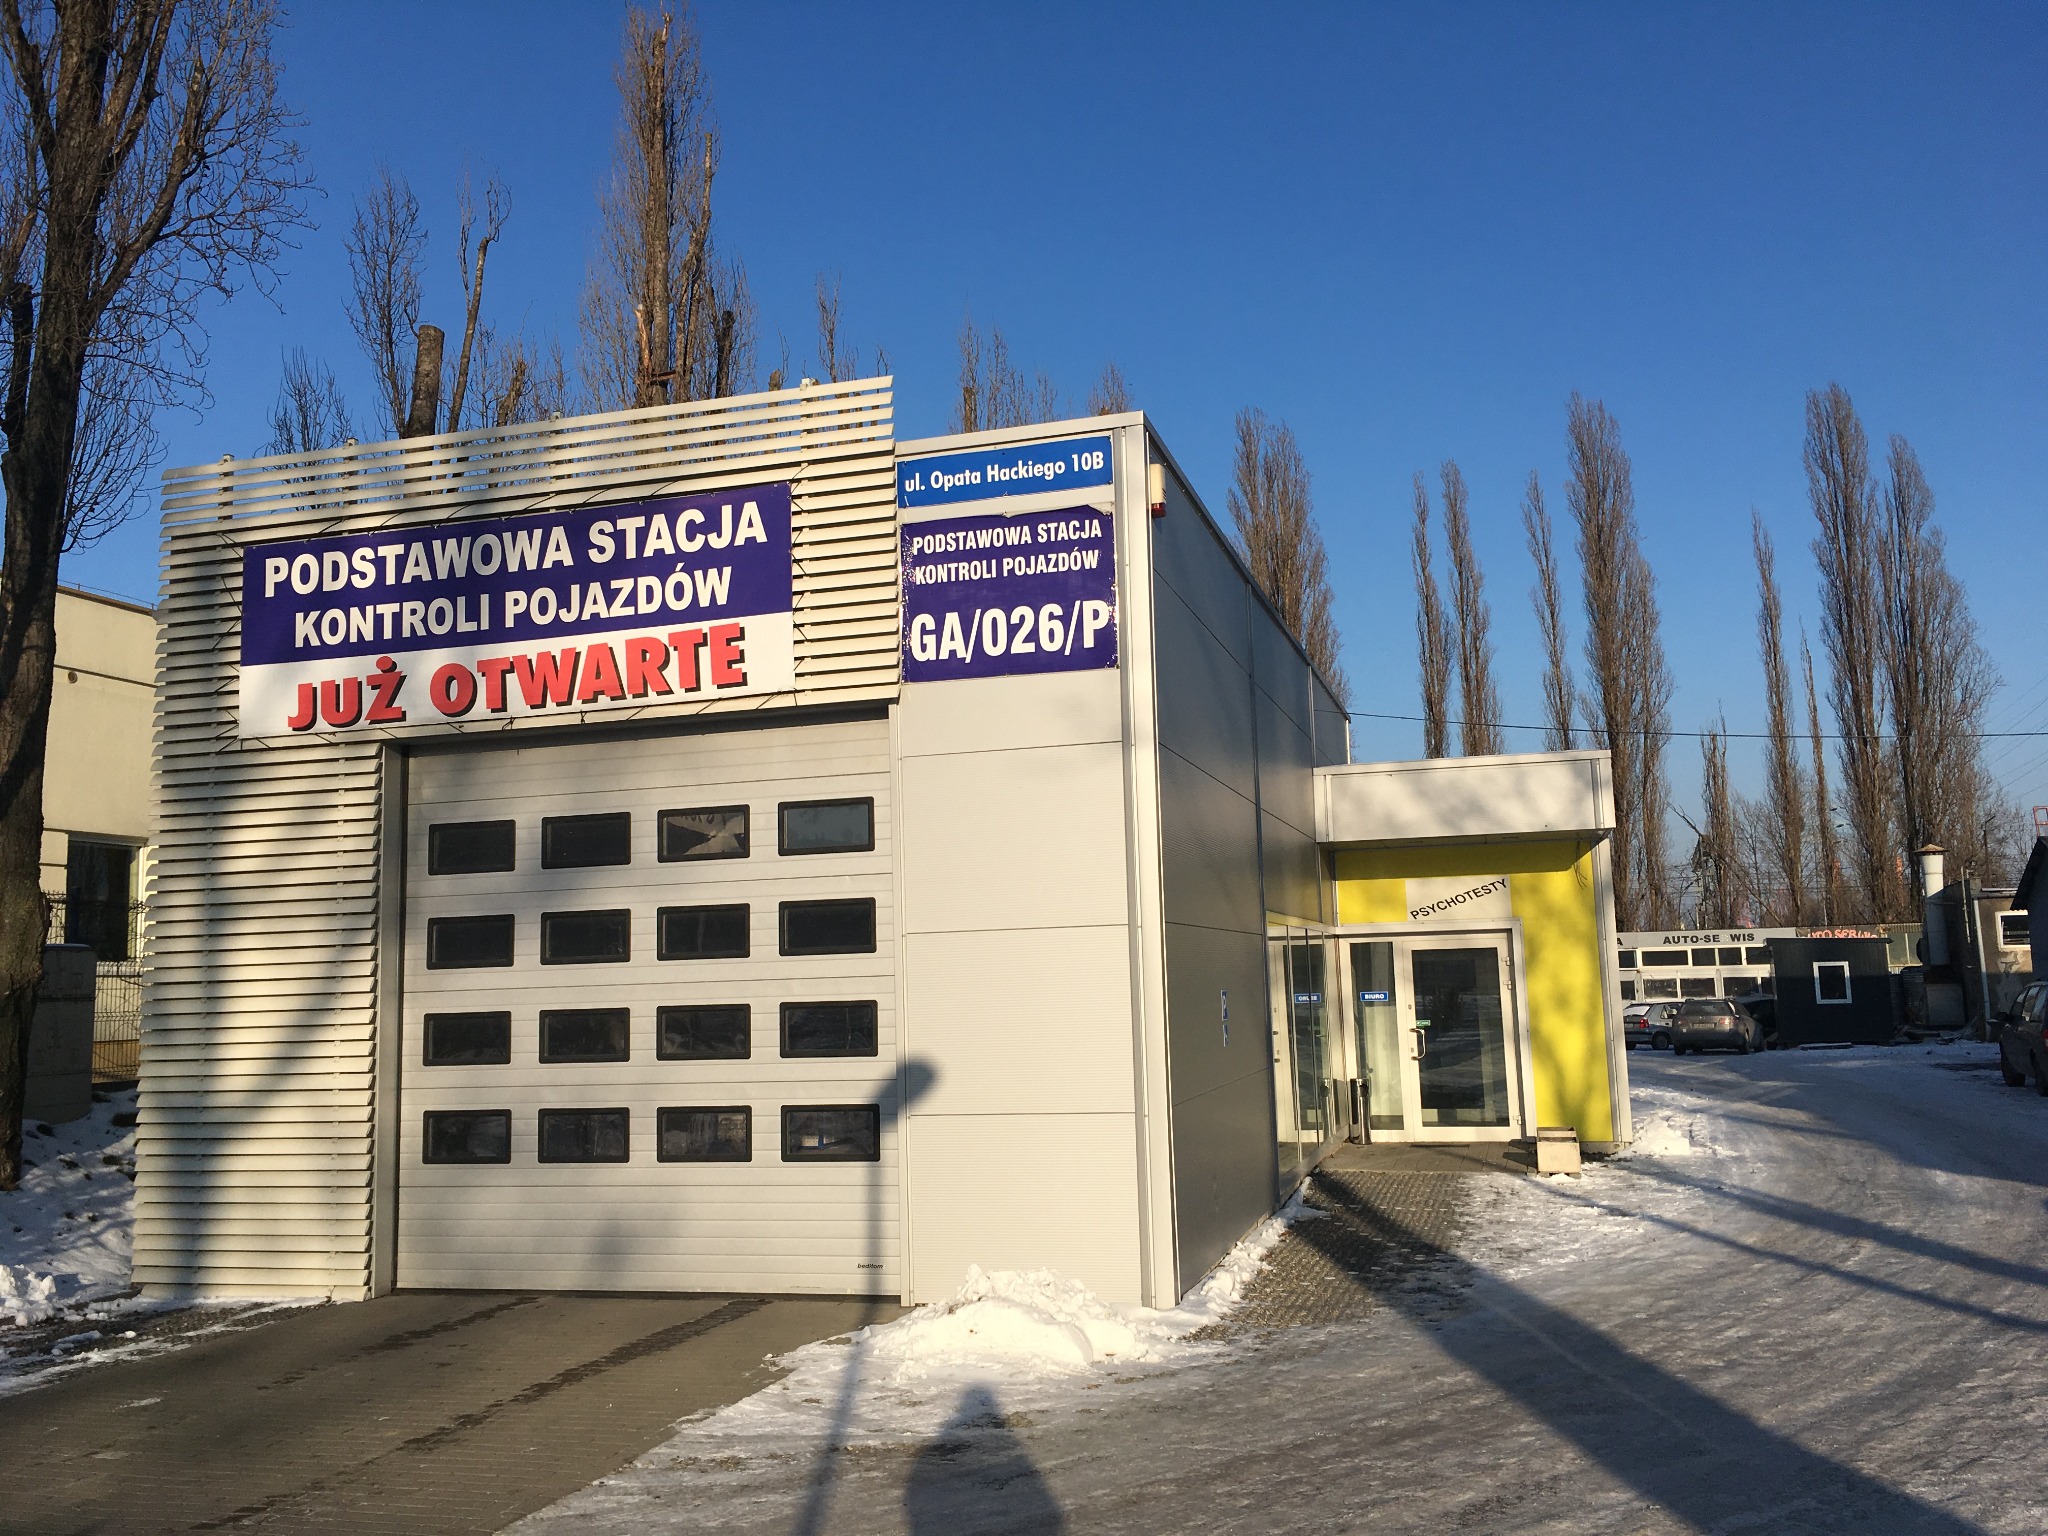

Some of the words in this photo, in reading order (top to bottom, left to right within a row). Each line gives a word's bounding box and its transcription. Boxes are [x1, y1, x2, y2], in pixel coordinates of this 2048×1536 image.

[904, 473, 926, 492] ul.
[930, 470, 981, 492] Opata
[987, 460, 1066, 480] Hackiego
[1071, 451, 1104, 472] 10B
[264, 525, 574, 599] PODSTAWOWA
[588, 501, 768, 564] STACJA
[913, 525, 1032, 555] PODSTAWOWA
[1037, 519, 1102, 543] STACJA
[915, 559, 997, 585] KONTROLI
[1003, 547, 1100, 577] POJAZDÓW
[295, 593, 490, 648] KONTROLI
[505, 563, 732, 628] POJAZDÓW
[911, 600, 1110, 663] GA/026/P
[287, 656, 406, 731] JUŻ
[429, 622, 748, 717] OTWARTE
[1410, 879, 1507, 920] PSYCHOTESTY
